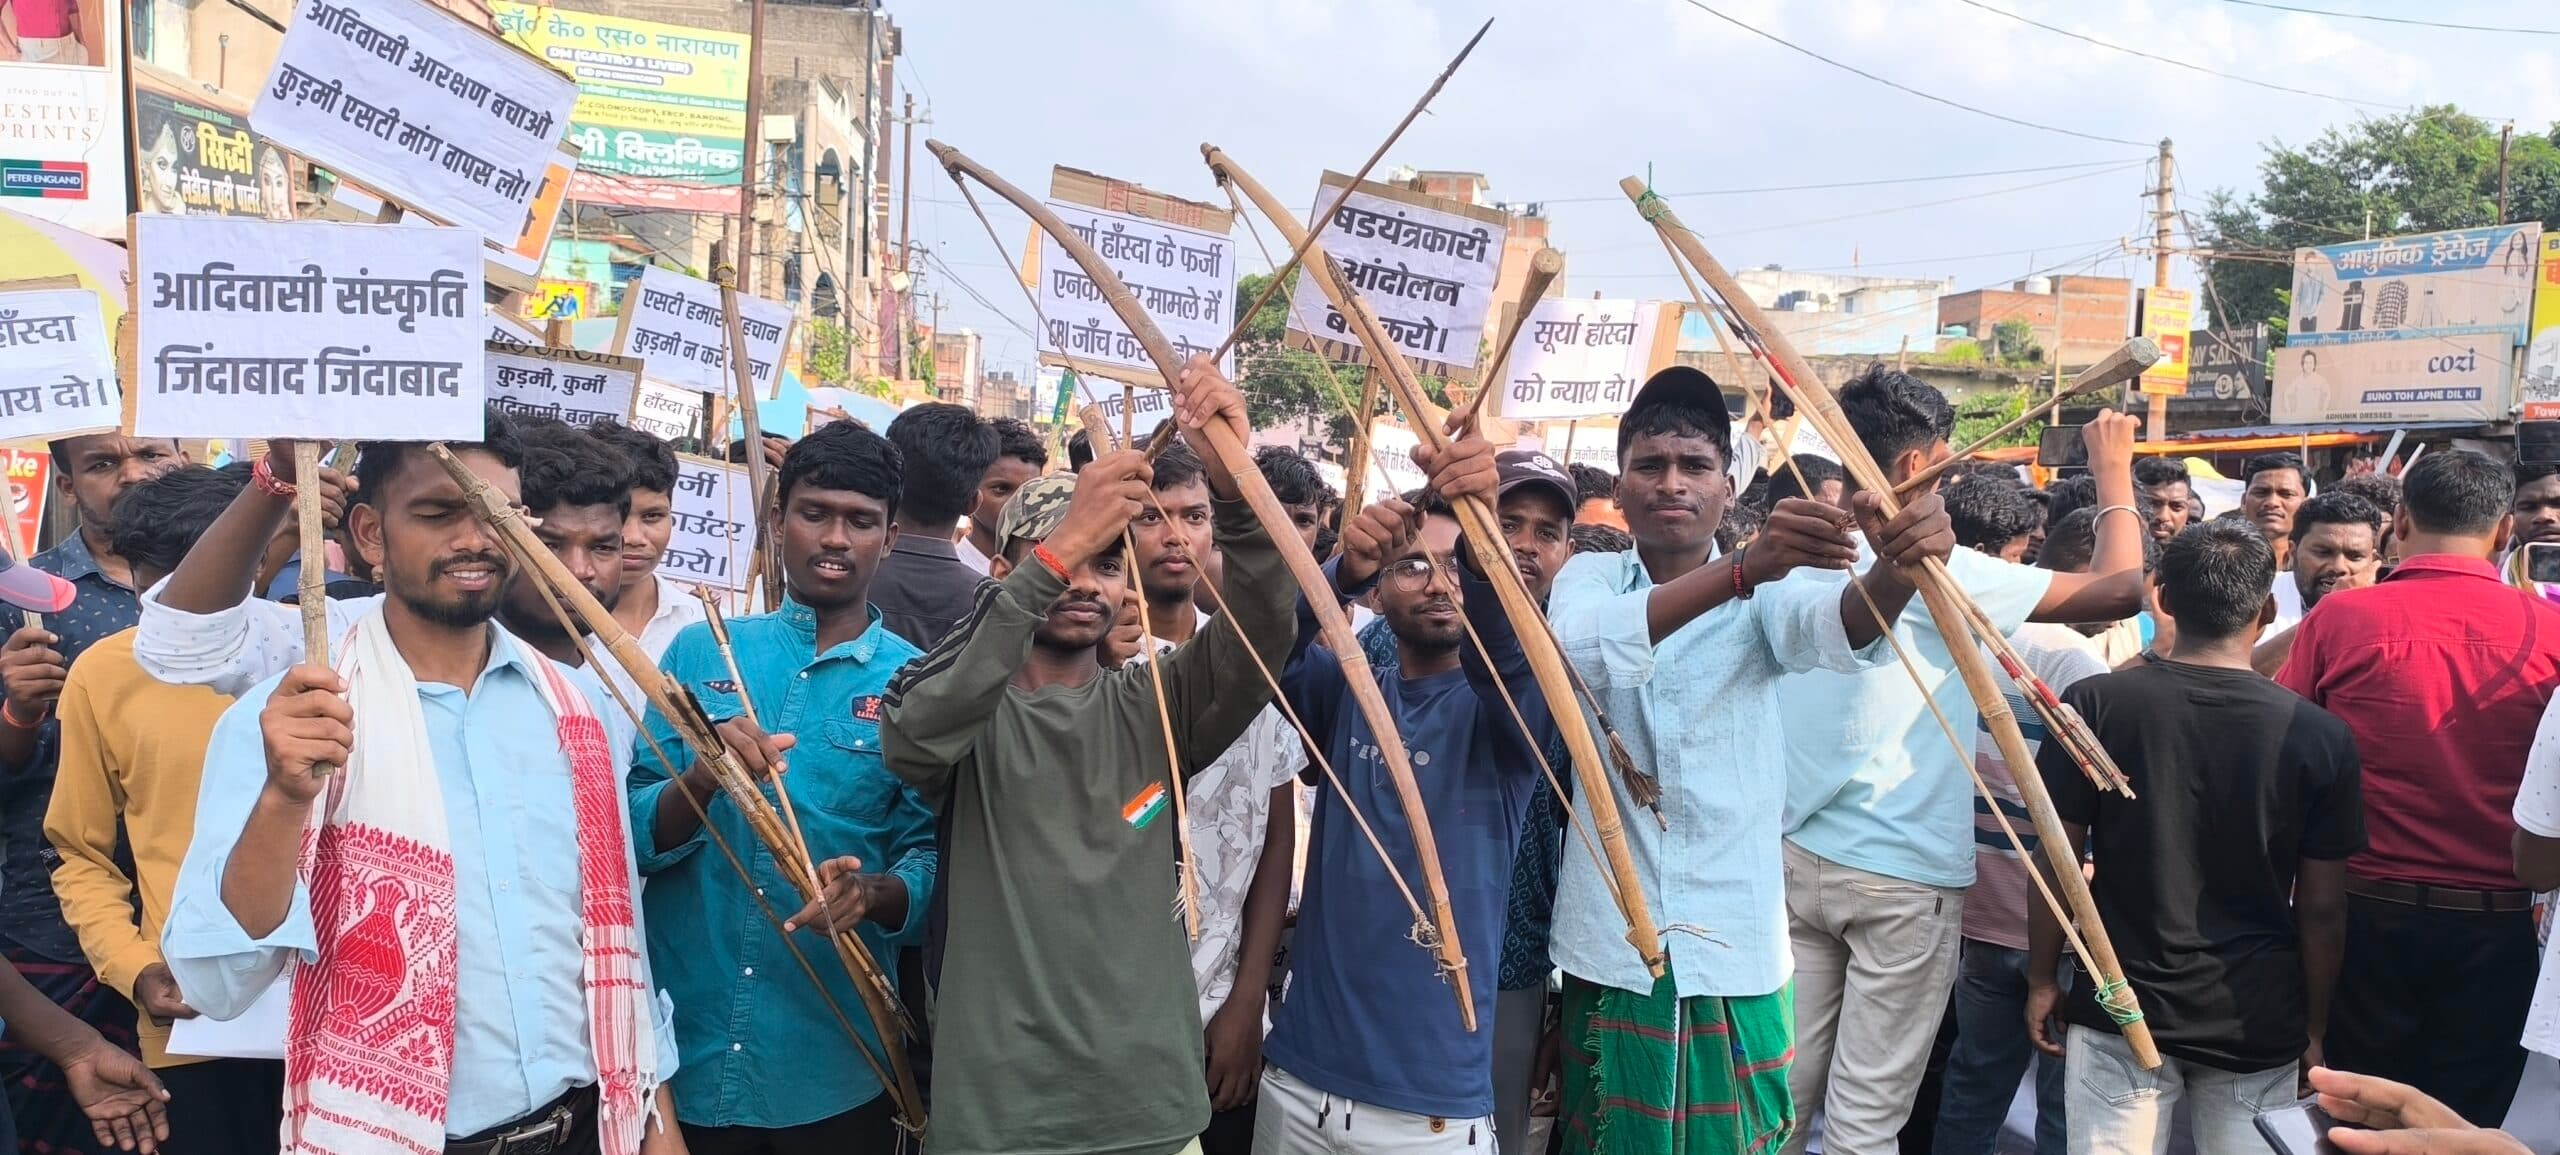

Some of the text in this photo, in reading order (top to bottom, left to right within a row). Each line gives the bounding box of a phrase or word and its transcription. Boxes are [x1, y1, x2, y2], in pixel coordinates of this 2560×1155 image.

[549, 46, 573, 58] DM
[656, 33, 739, 60] नारायण
[306, 0, 410, 66] आदिवासी
[408, 47, 490, 108] आरक्षण
[490, 92, 553, 140] बचाओ
[4, 103, 99, 122] ESTIVE
[272, 62, 343, 113] कुड़मी
[341, 93, 399, 141] एसटी
[398, 121, 443, 163] मांग
[442, 142, 496, 188] वापस
[494, 165, 531, 204] लो!
[615, 131, 741, 169] क्लिनिक
[7, 173, 81, 185] PETER ENGLAND
[1101, 222, 1152, 264] हाँस्दा
[1156, 234, 1176, 268] के
[1181, 243, 1223, 278] फर्जी
[2337, 234, 2491, 276] आधुनिक ड्रेसेज
[153, 262, 327, 313] आदिवासी
[333, 267, 468, 333] संस्कृति
[1342, 257, 1465, 307] आंदोलन
[643, 288, 685, 316] एसटी
[740, 315, 783, 344] हचान
[1146, 286, 1201, 320] मामले
[1204, 289, 1223, 324] में
[632, 327, 682, 355] कुड़मी
[683, 340, 699, 361] न
[1073, 317, 1112, 356] जाँच
[1534, 313, 1638, 354] सूर्या हाँस्दा
[155, 342, 463, 397] जिंदाबाद जिंदाबाद
[2428, 347, 2478, 373] cozi
[496, 365, 608, 396] कुड़मी, कुर्मी
[1513, 373, 1545, 403] को
[1550, 380, 1600, 404] न्याय
[2366, 389, 2477, 401] SUNO TOH APNE DIL KI
[2359, 411, 2393, 420] DRESSES
